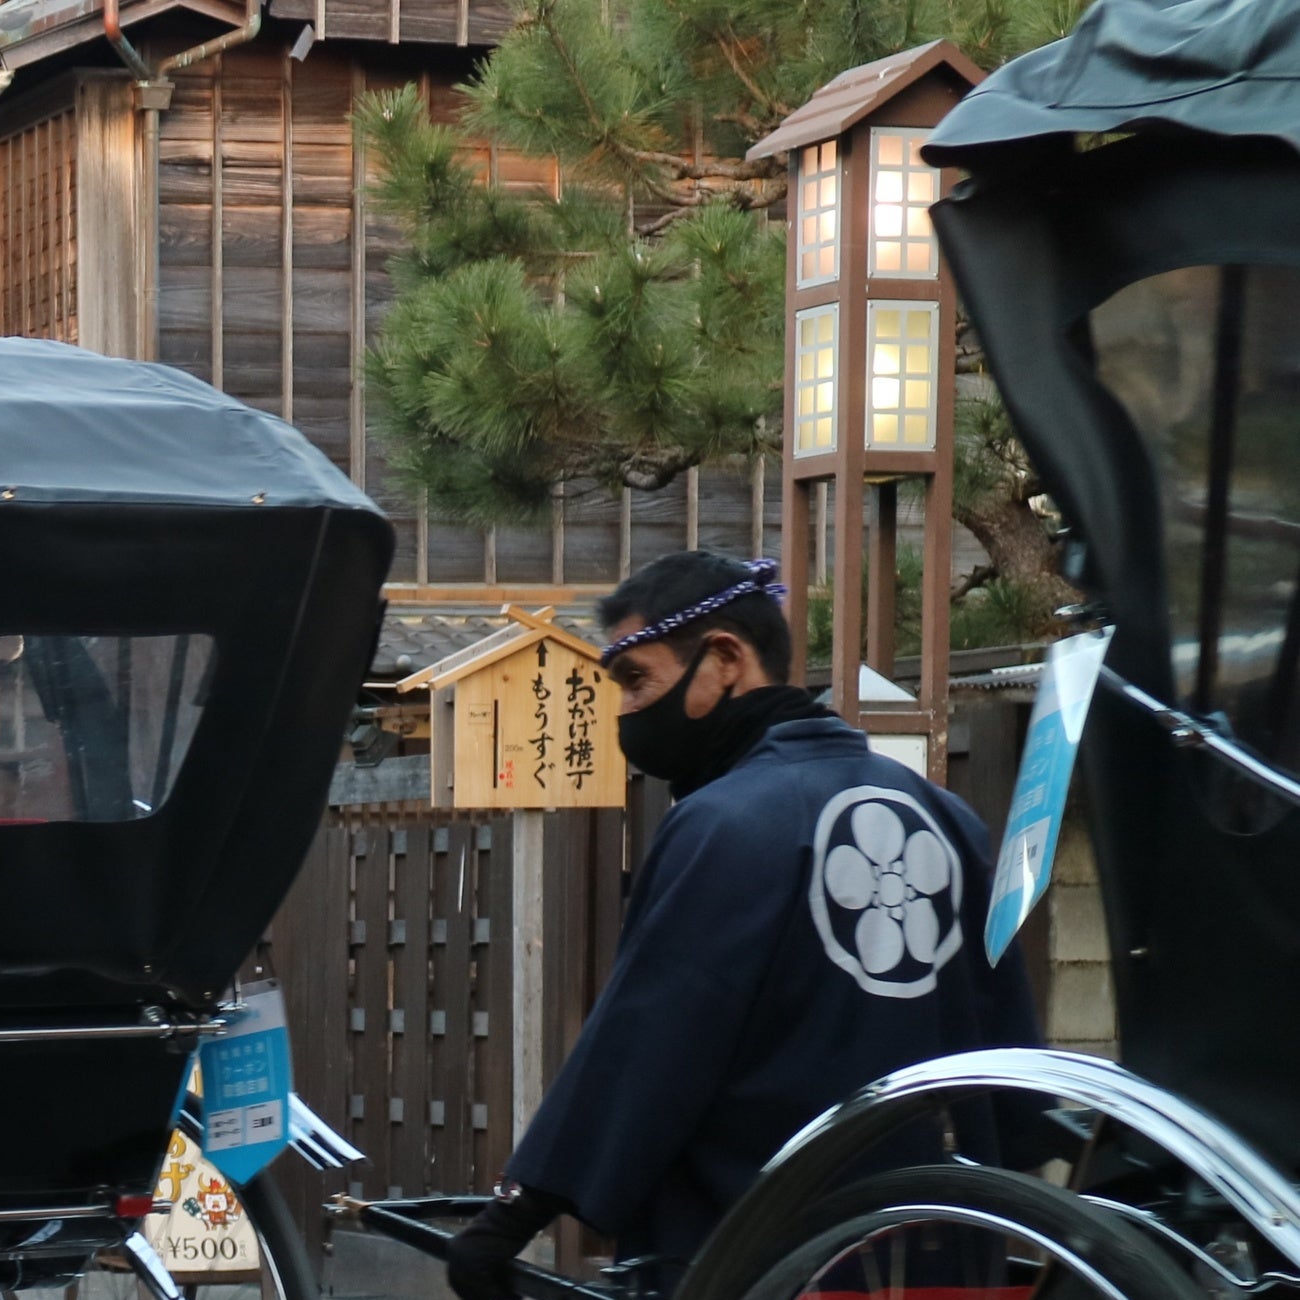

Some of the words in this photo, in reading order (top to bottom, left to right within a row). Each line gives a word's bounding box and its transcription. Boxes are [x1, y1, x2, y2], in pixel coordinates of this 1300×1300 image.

[528, 672, 556, 789] もうすぐ
[564, 667, 602, 790] おかげ横丁
[167, 1236, 237, 1260] ¥500
